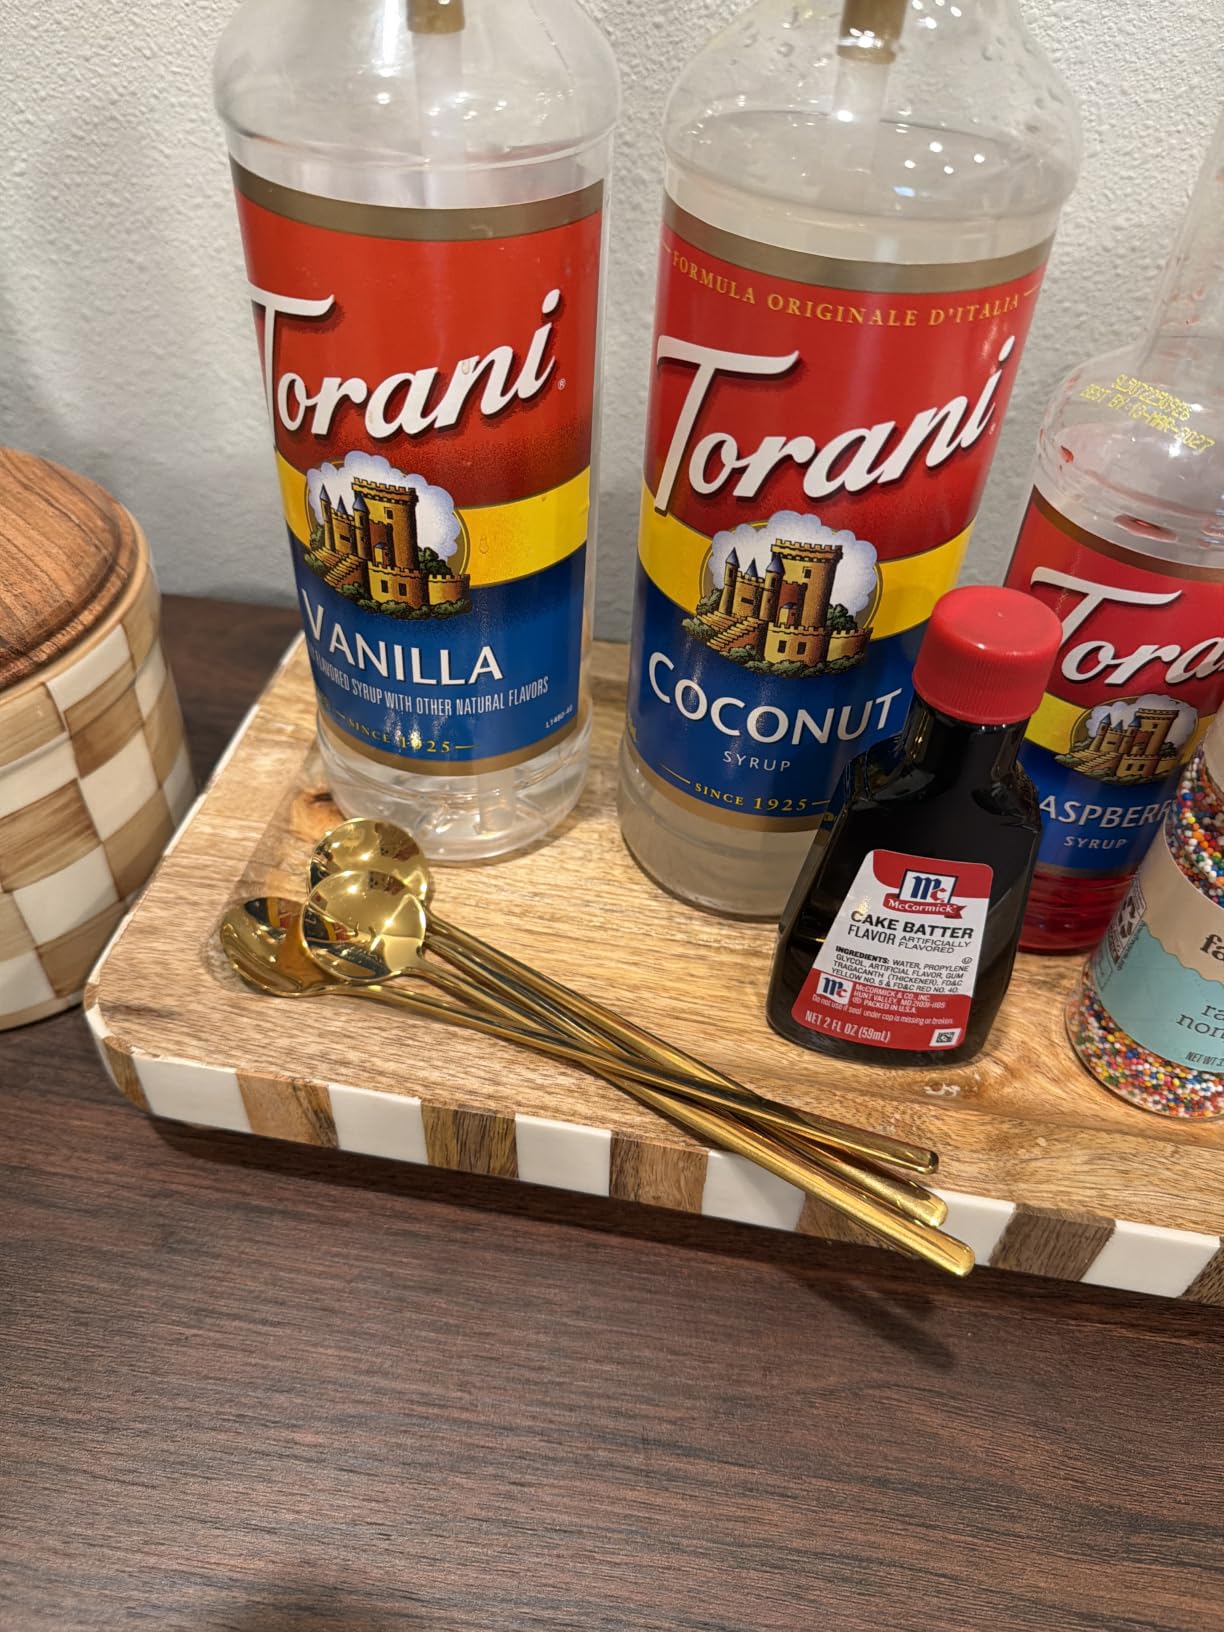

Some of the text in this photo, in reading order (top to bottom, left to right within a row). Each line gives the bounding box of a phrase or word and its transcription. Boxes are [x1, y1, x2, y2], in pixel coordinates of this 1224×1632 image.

[672, 251, 1019, 326] FORMULA ORIGINALE D'ITALIA
[250, 283, 560, 438] Torani
[654, 335, 1015, 515] Torani
[302, 587, 504, 685] VANILLA
[1031, 566, 1224, 685] Tora
[351, 678, 383, 705] SYRUP
[384, 690, 412, 713] WITH
[416, 698, 451, 716] OTHER
[456, 694, 505, 716] NATURAL
[508, 676, 549, 707] FLAVORS
[648, 652, 903, 745] COCONUT
[348, 718, 391, 743] SINCE
[723, 750, 792, 773] SYRUP
[694, 783, 808, 812] SINCE 1925
[1039, 794, 1173, 828] ASPBERR
[1063, 836, 1127, 850] SYRUP
[887, 898, 955, 914] McCormick
[847, 924, 972, 948] FLAVOR ARTIFICIALLY
[850, 910, 974, 940] CAKE BATTER
[835, 945, 970, 972] INGREDIENTS: WATER, PROPYLENE
[897, 942, 955, 954] FLAVORED
[1200, 934, 1224, 962] fa
[831, 967, 864, 981] YELLOW
[893, 982, 915, 992] FD&C
[915, 985, 931, 993] RED
[833, 960, 884, 978] TRAGACANTH
[868, 962, 910, 976] ARTIFICIAL
[853, 991, 872, 1001] HUNT
[855, 984, 896, 997] McCORMICK
[831, 1001, 842, 1010] use
[863, 1010, 881, 1019] under
[863, 1000, 890, 1011] PACKED
[890, 1004, 898, 1012] IN
[1201, 1004, 1224, 1021] ra
[804, 1010, 891, 1043] NET 2 FL OZ (59mL)
[1176, 1014, 1224, 1039] non
